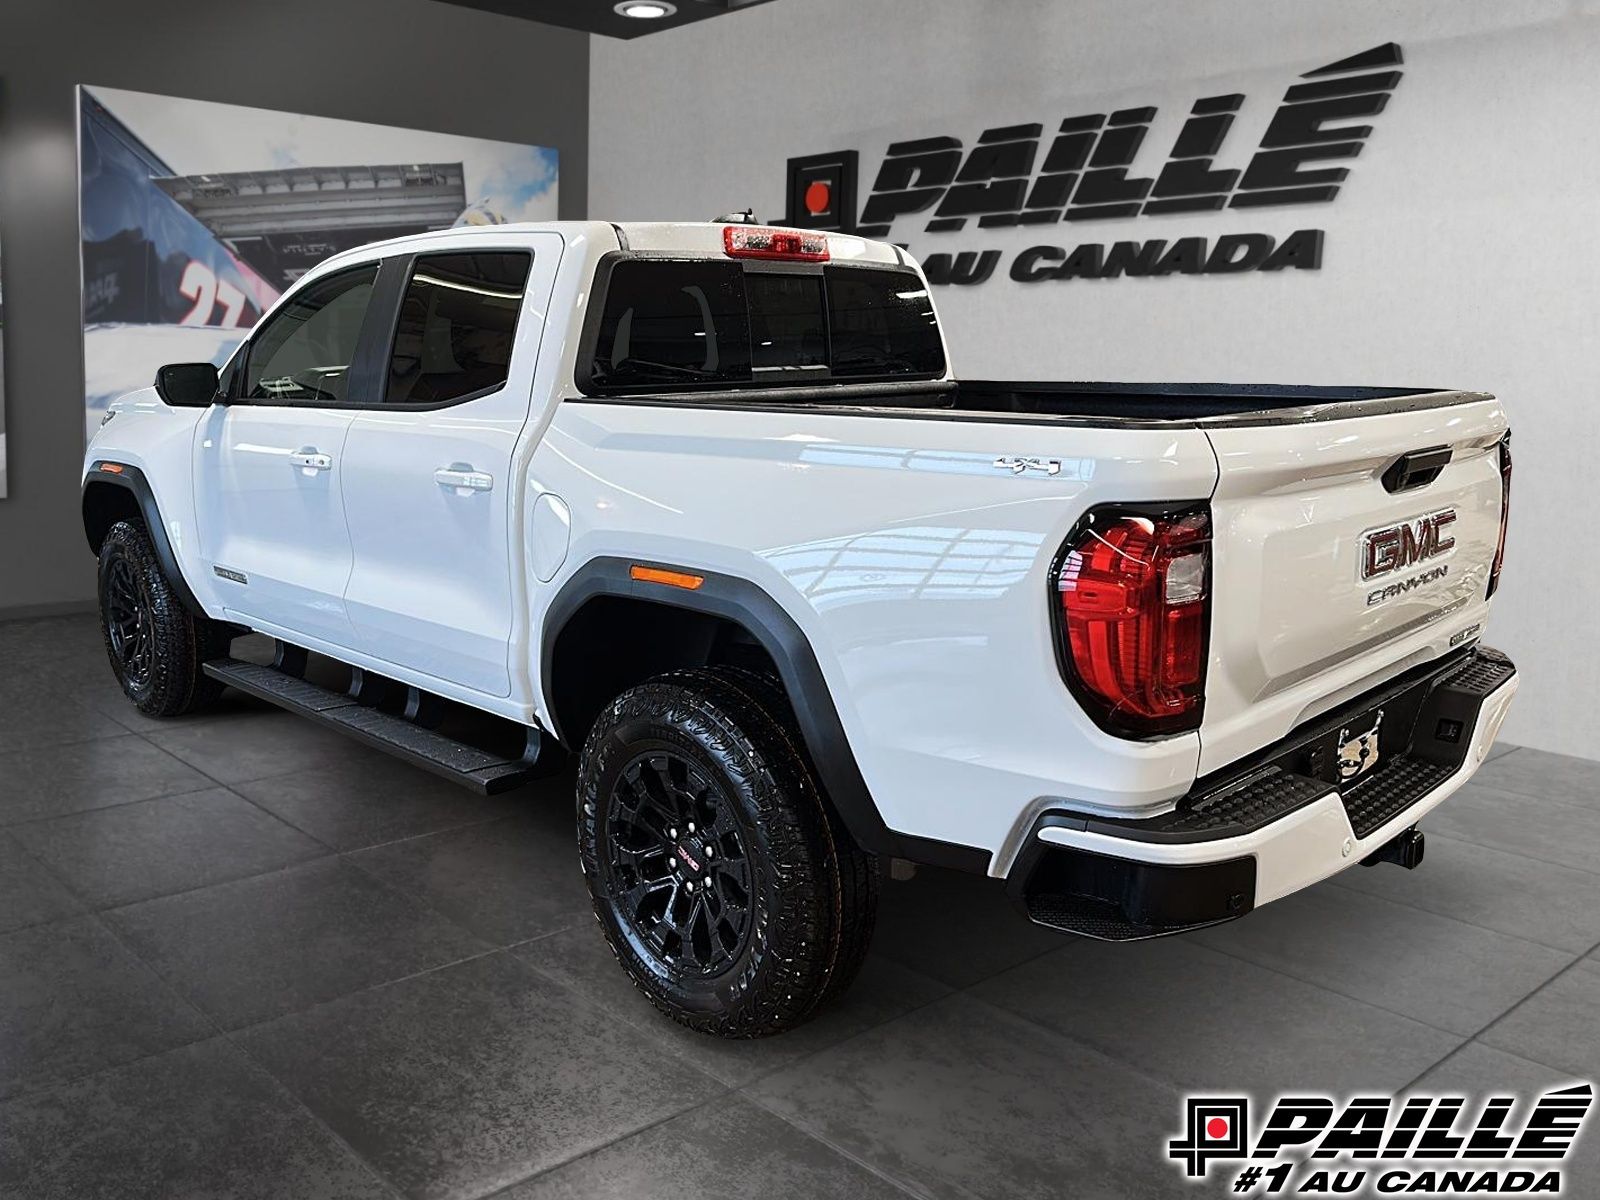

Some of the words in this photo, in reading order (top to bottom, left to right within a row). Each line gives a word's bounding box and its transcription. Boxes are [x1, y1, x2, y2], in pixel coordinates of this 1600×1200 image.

[859, 42, 1403, 236] PAILLÉ
[921, 250, 1002, 286] AU
[1009, 229, 1325, 283] CANADA
[1363, 508, 1457, 580] GMC
